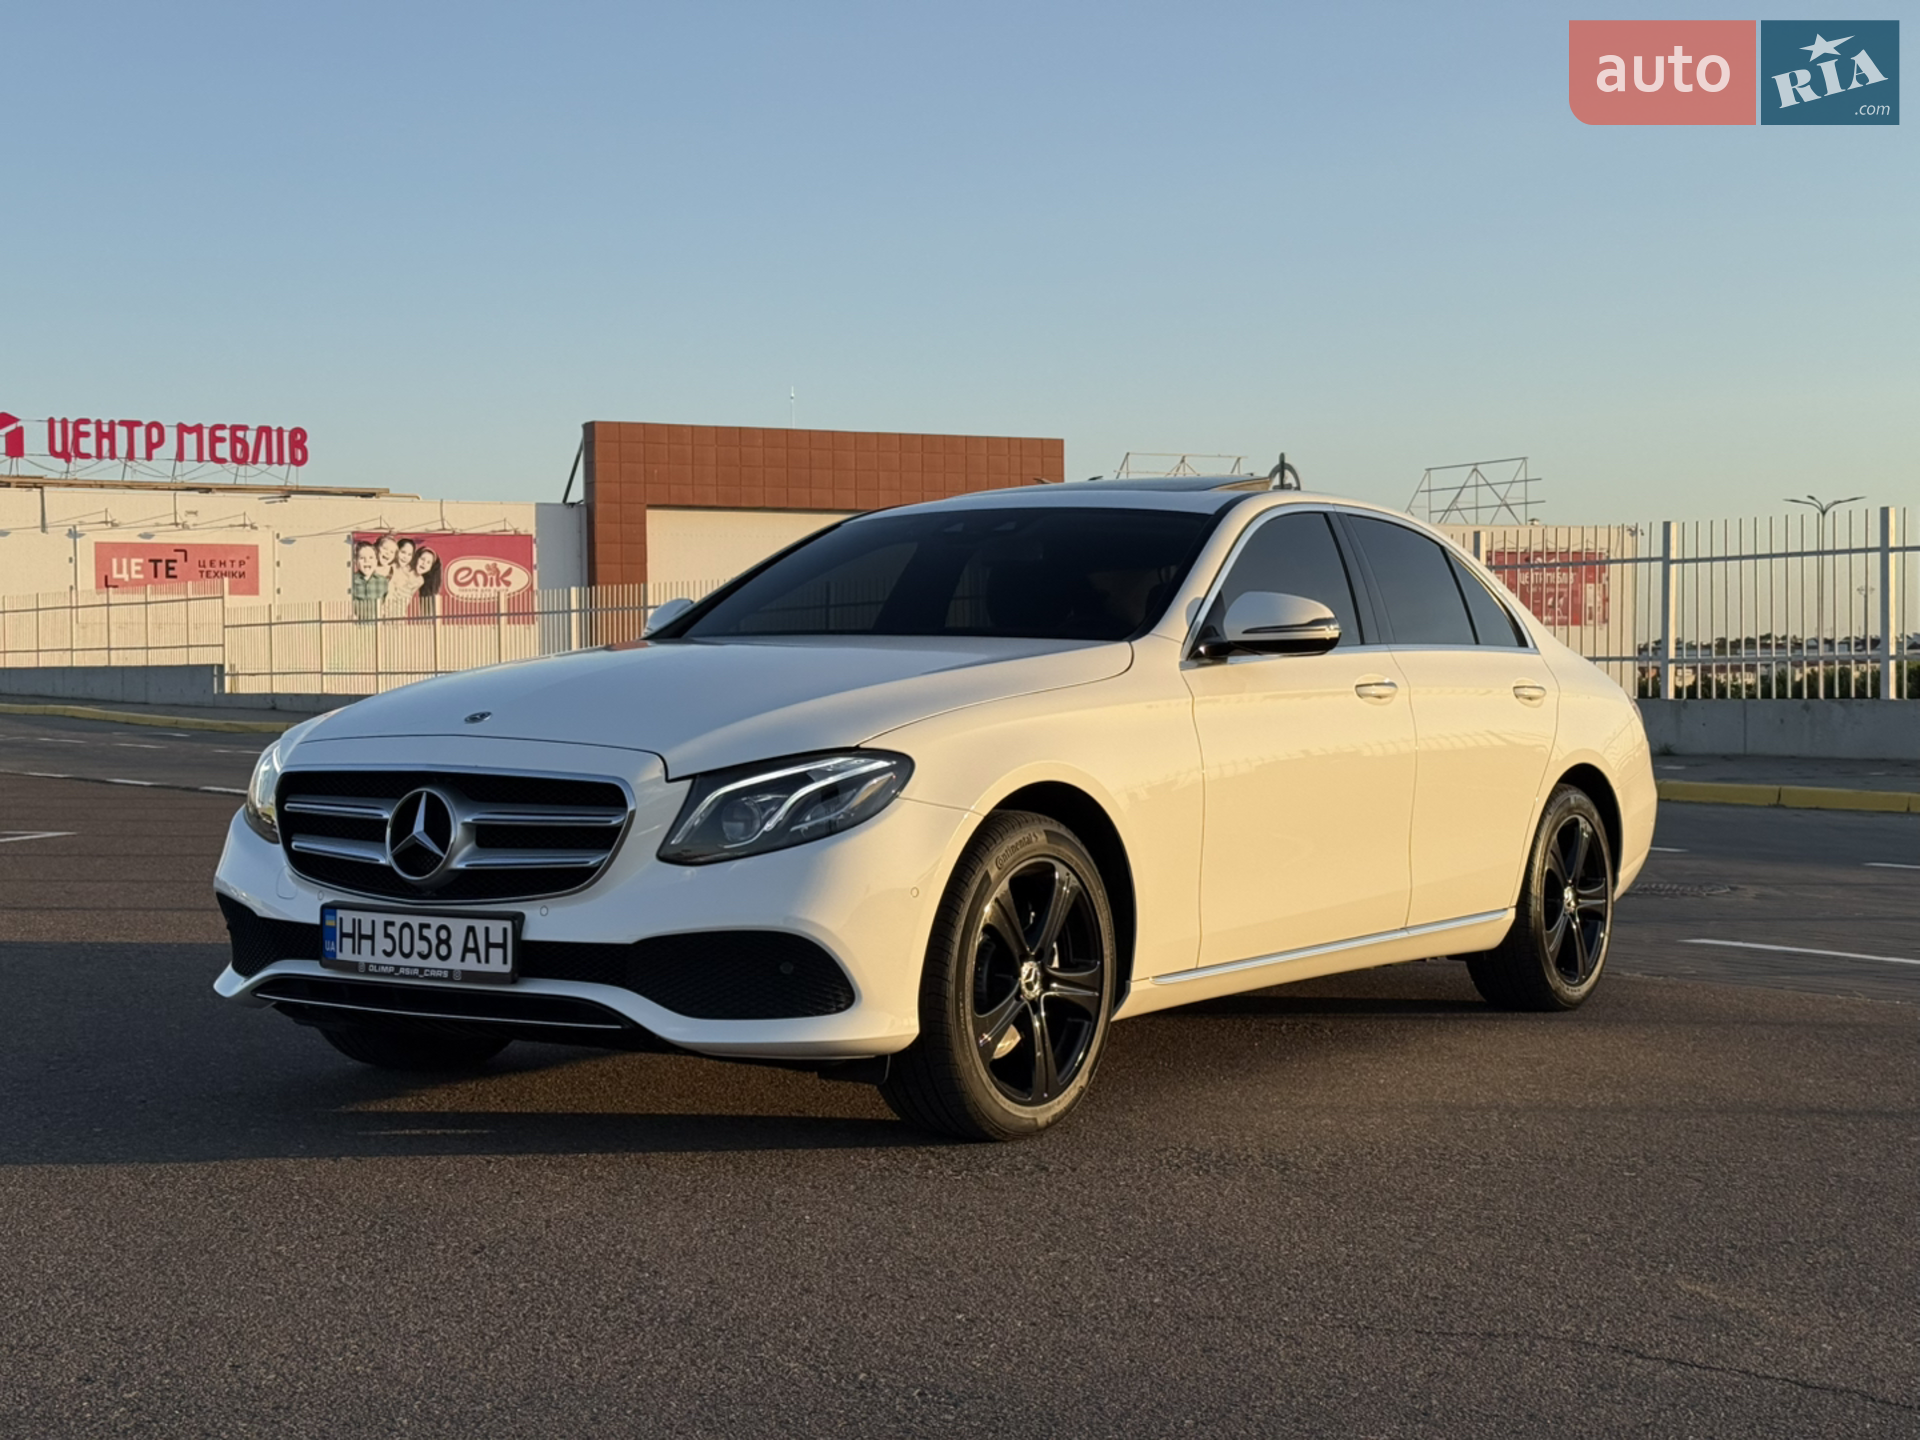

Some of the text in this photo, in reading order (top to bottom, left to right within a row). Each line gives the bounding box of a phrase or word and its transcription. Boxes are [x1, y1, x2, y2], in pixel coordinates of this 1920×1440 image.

[48, 416, 308, 467] ЦЕНТР МЕБЛІВ
[111, 557, 178, 581] ЦЕ ТЕ
[198, 560, 246, 569] ЦЕНТР
[198, 570, 246, 579] ТЕХНІКИ
[325, 940, 336, 952] UA
[381, 920, 452, 962] 5058
[460, 925, 508, 965] AH
